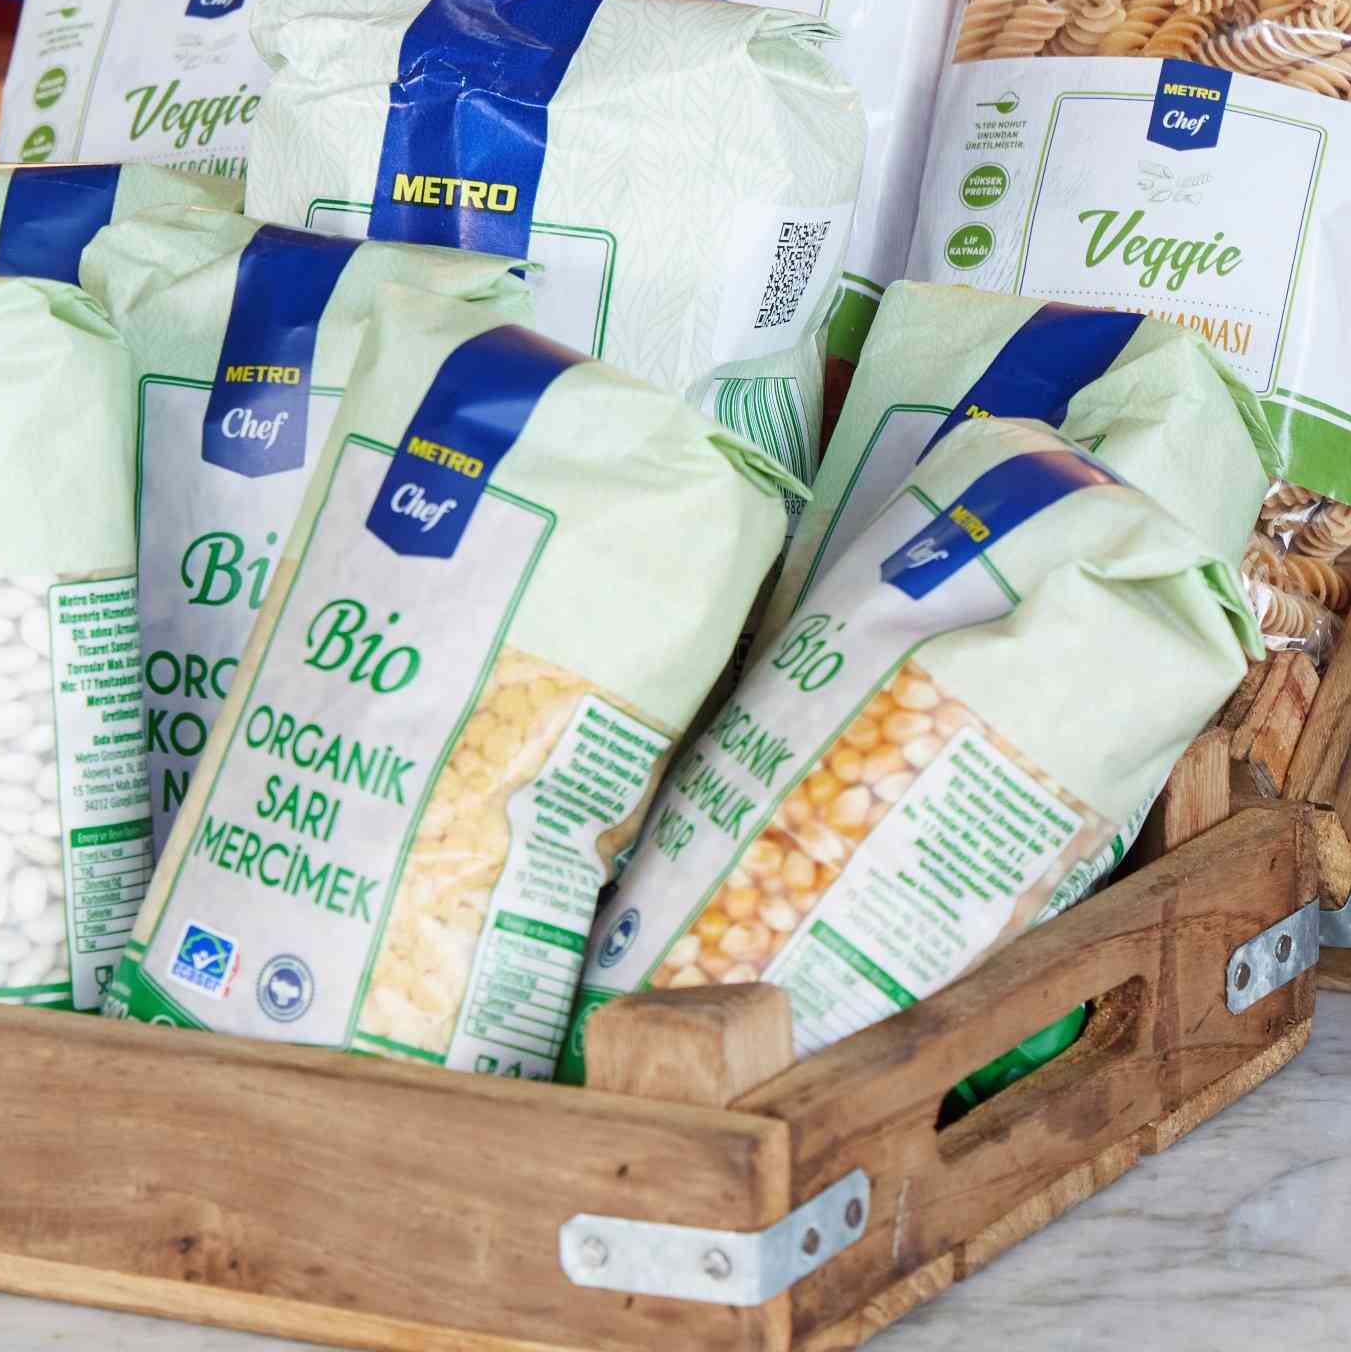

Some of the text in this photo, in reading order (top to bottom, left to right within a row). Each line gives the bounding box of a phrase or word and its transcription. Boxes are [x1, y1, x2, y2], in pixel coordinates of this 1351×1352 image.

[124, 79, 262, 149] Veggie
[1162, 108, 1210, 136] Chef
[1163, 83, 1221, 102] METRO
[392, 172, 518, 214] METRO
[1078, 210, 1243, 291] Veggie
[225, 365, 301, 386] METRO
[221, 407, 289, 449] Chef
[406, 436, 485, 478] METRO
[390, 481, 458, 533] Chef
[951, 504, 992, 544] METRO
[180, 530, 278, 609] Bi
[305, 598, 422, 695] Bio
[770, 614, 846, 692] Bio
[246, 704, 418, 806] ORGANİK
[256, 774, 341, 842] SARI
[196, 813, 383, 926] MERCİMEK
